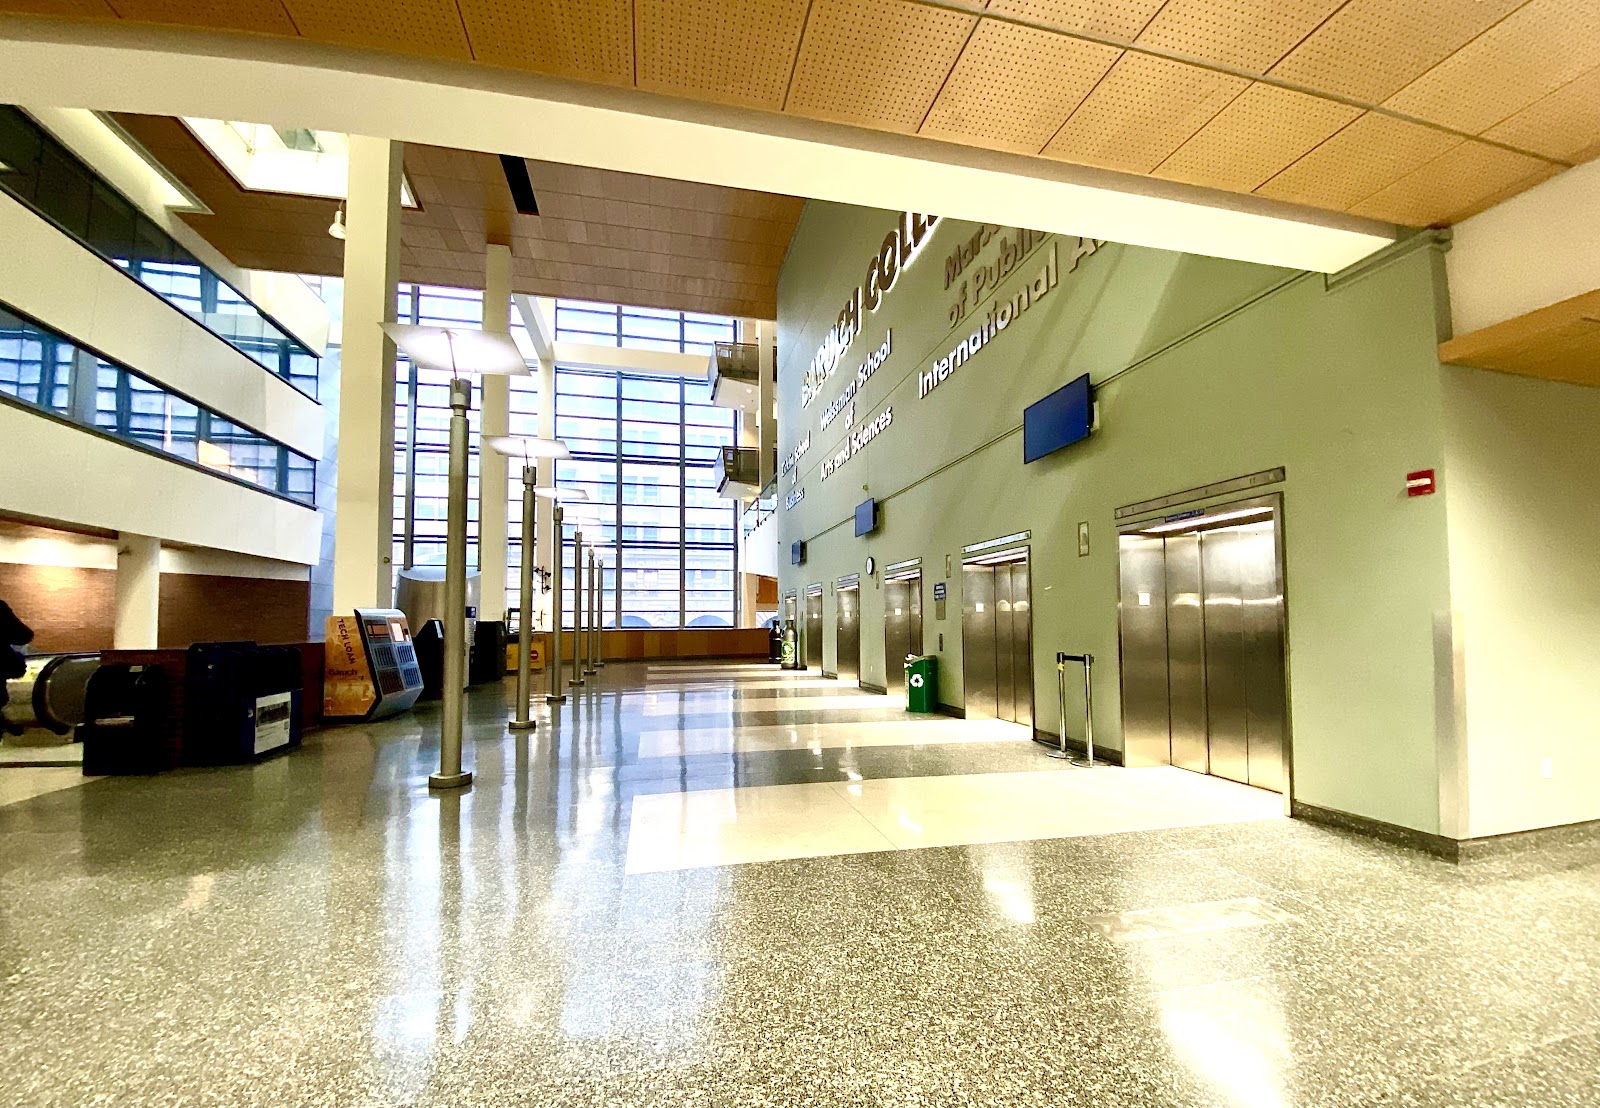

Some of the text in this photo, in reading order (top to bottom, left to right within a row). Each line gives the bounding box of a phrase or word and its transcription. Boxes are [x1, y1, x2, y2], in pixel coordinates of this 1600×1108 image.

[919, 236, 1108, 400] International A
[949, 280, 967, 328] of
[802, 286, 864, 409] BARUCH
[820, 328, 892, 432] Weissman School
[820, 458, 835, 482] Arts
[834, 436, 851, 469] and
[851, 406, 893, 455] Sciences
[845, 401, 856, 430] of
[337, 618, 357, 665] TECH LOAN
